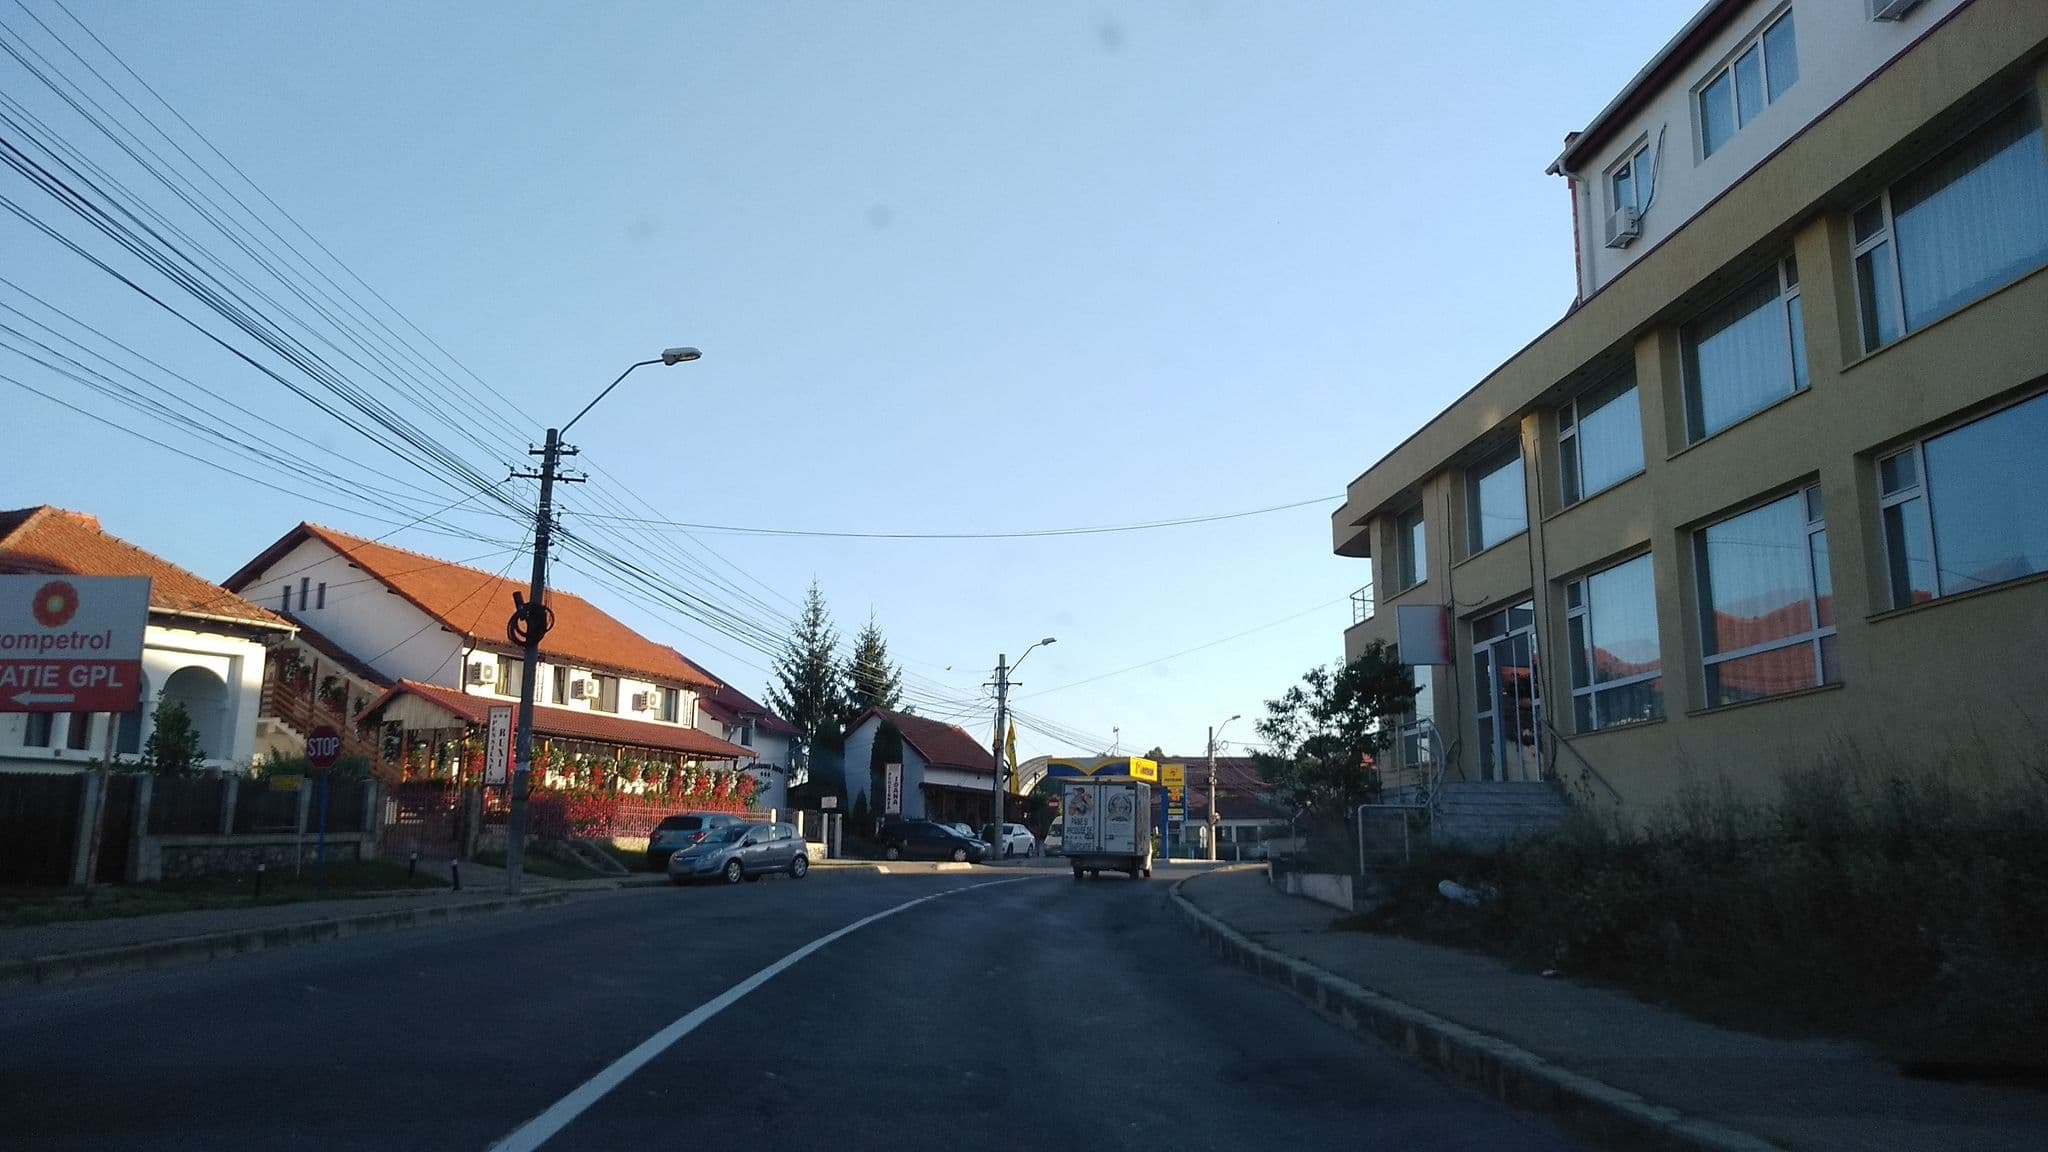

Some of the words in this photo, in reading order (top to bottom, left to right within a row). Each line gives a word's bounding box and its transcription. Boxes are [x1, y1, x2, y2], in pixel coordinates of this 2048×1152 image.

[0, 665, 61, 688] ATIE
[69, 664, 124, 688] GPL
[308, 737, 340, 757] STOP
